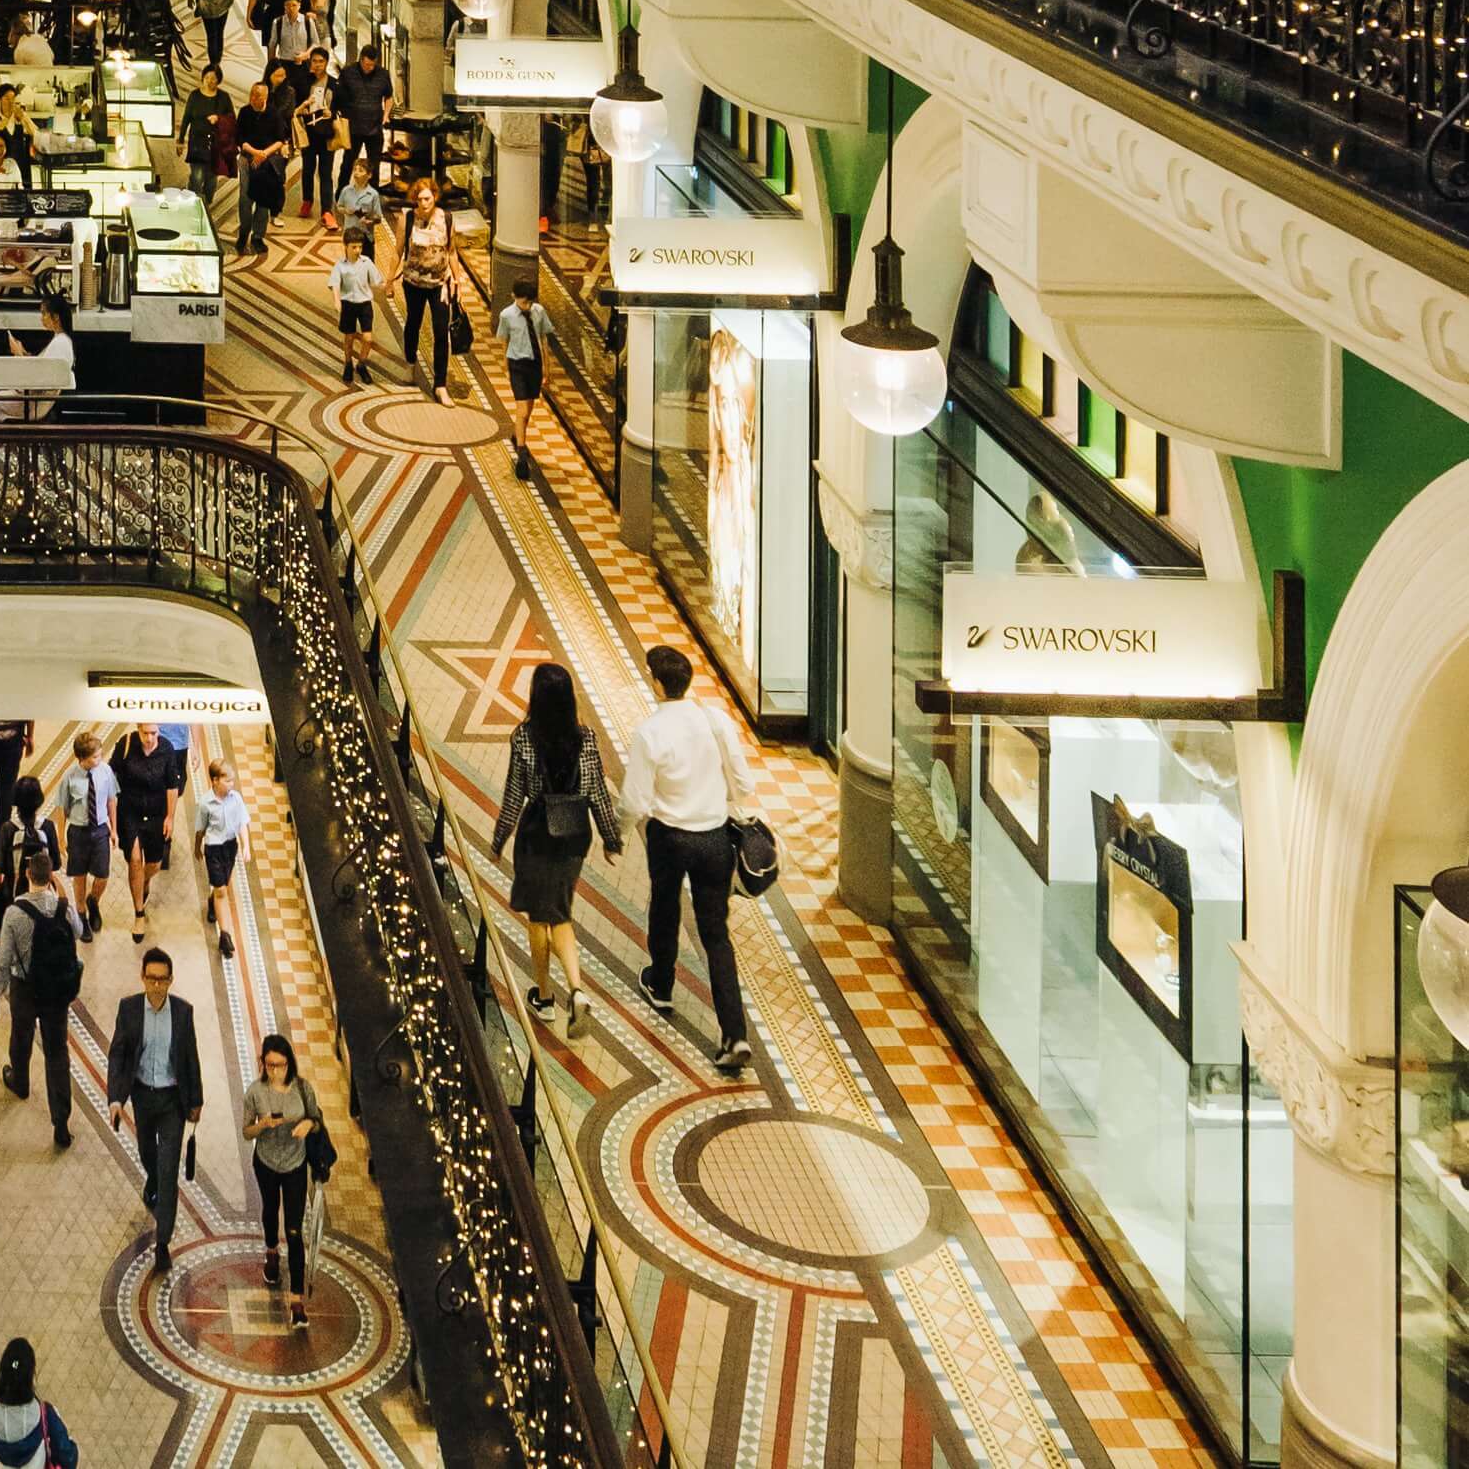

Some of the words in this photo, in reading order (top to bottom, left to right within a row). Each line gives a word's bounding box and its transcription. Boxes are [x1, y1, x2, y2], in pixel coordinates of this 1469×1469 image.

[652, 248, 754, 266] SWAROVSKI
[179, 304, 219, 317] PARISI
[1003, 626, 1156, 653] SWAROVSKI
[107, 696, 261, 714] dermalogica
